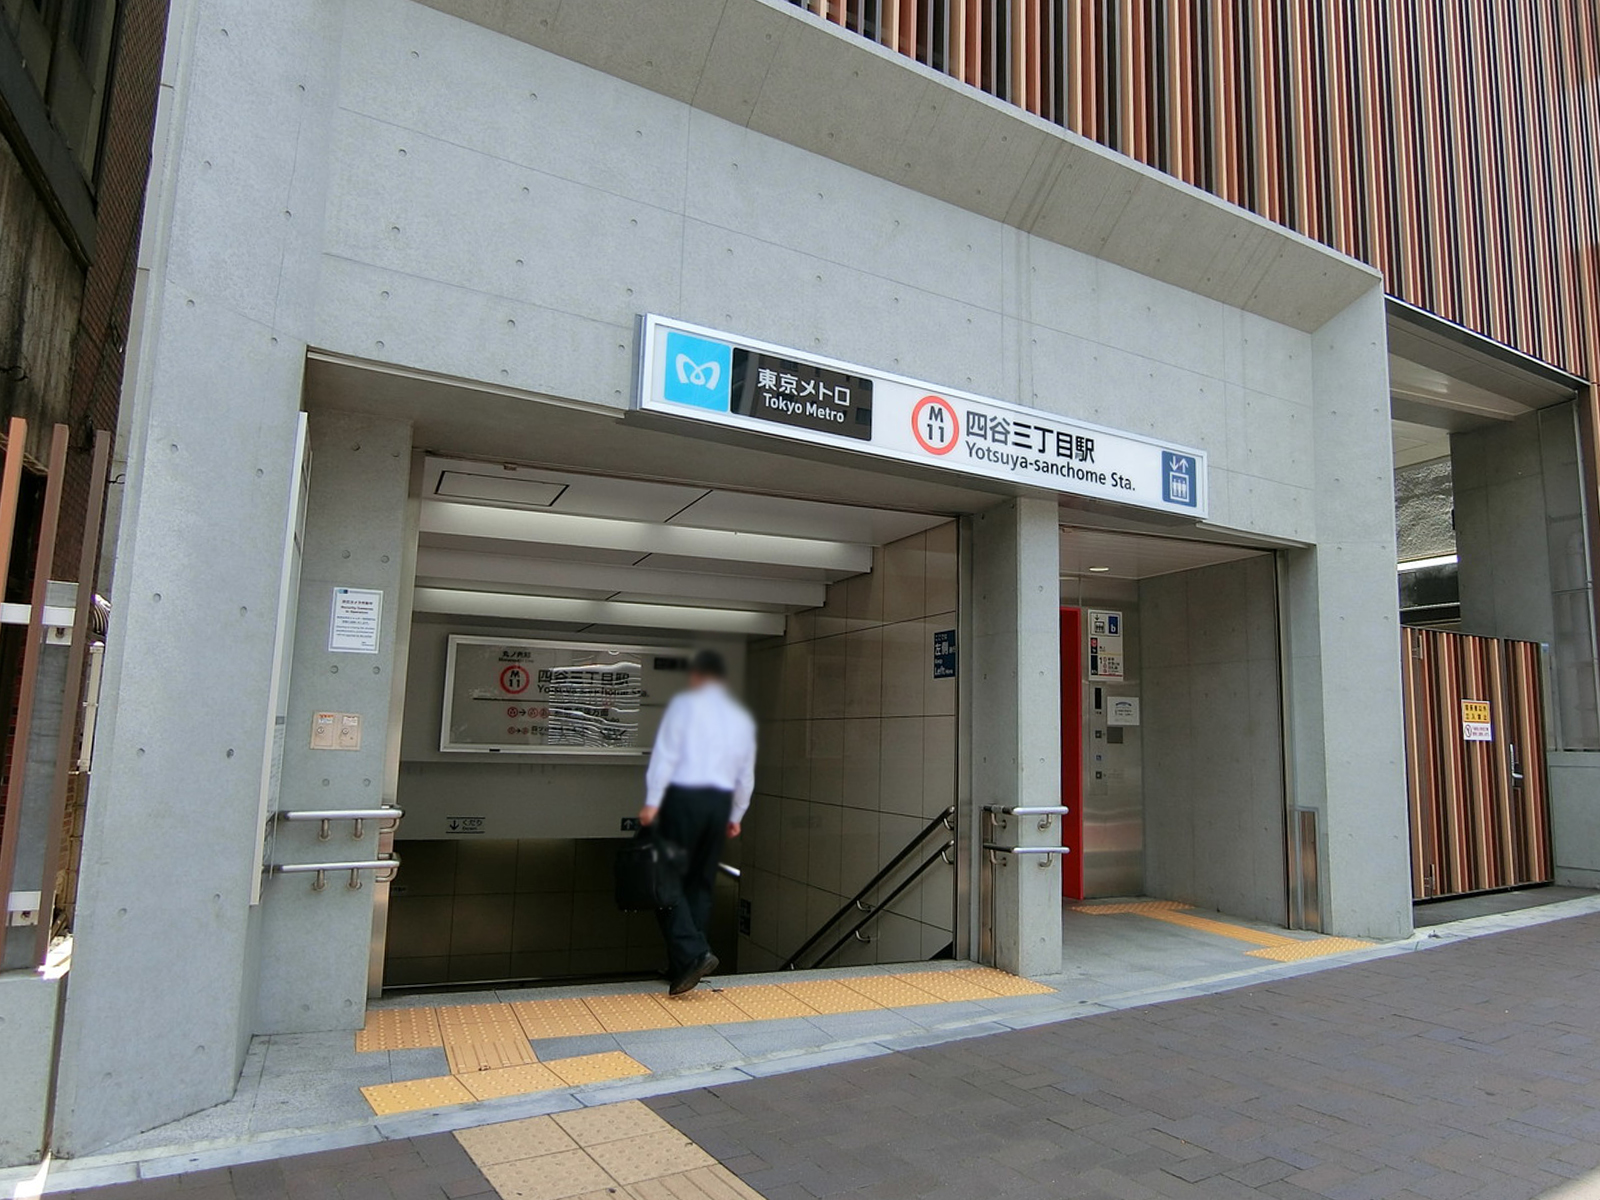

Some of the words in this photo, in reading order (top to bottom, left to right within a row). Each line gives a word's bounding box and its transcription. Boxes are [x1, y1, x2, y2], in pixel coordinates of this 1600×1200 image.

[757, 367, 851, 407] 東京メトロ
[763, 392, 803, 415] Tokyo
[805, 402, 845, 424] Metro
[928, 405, 944, 423] M
[926, 423, 945, 443] 11
[965, 410, 1095, 464] 四谷三丁目駅
[965, 440, 1107, 486] Yotsuya-sanchome
[1110, 471, 1136, 491] Sta.
